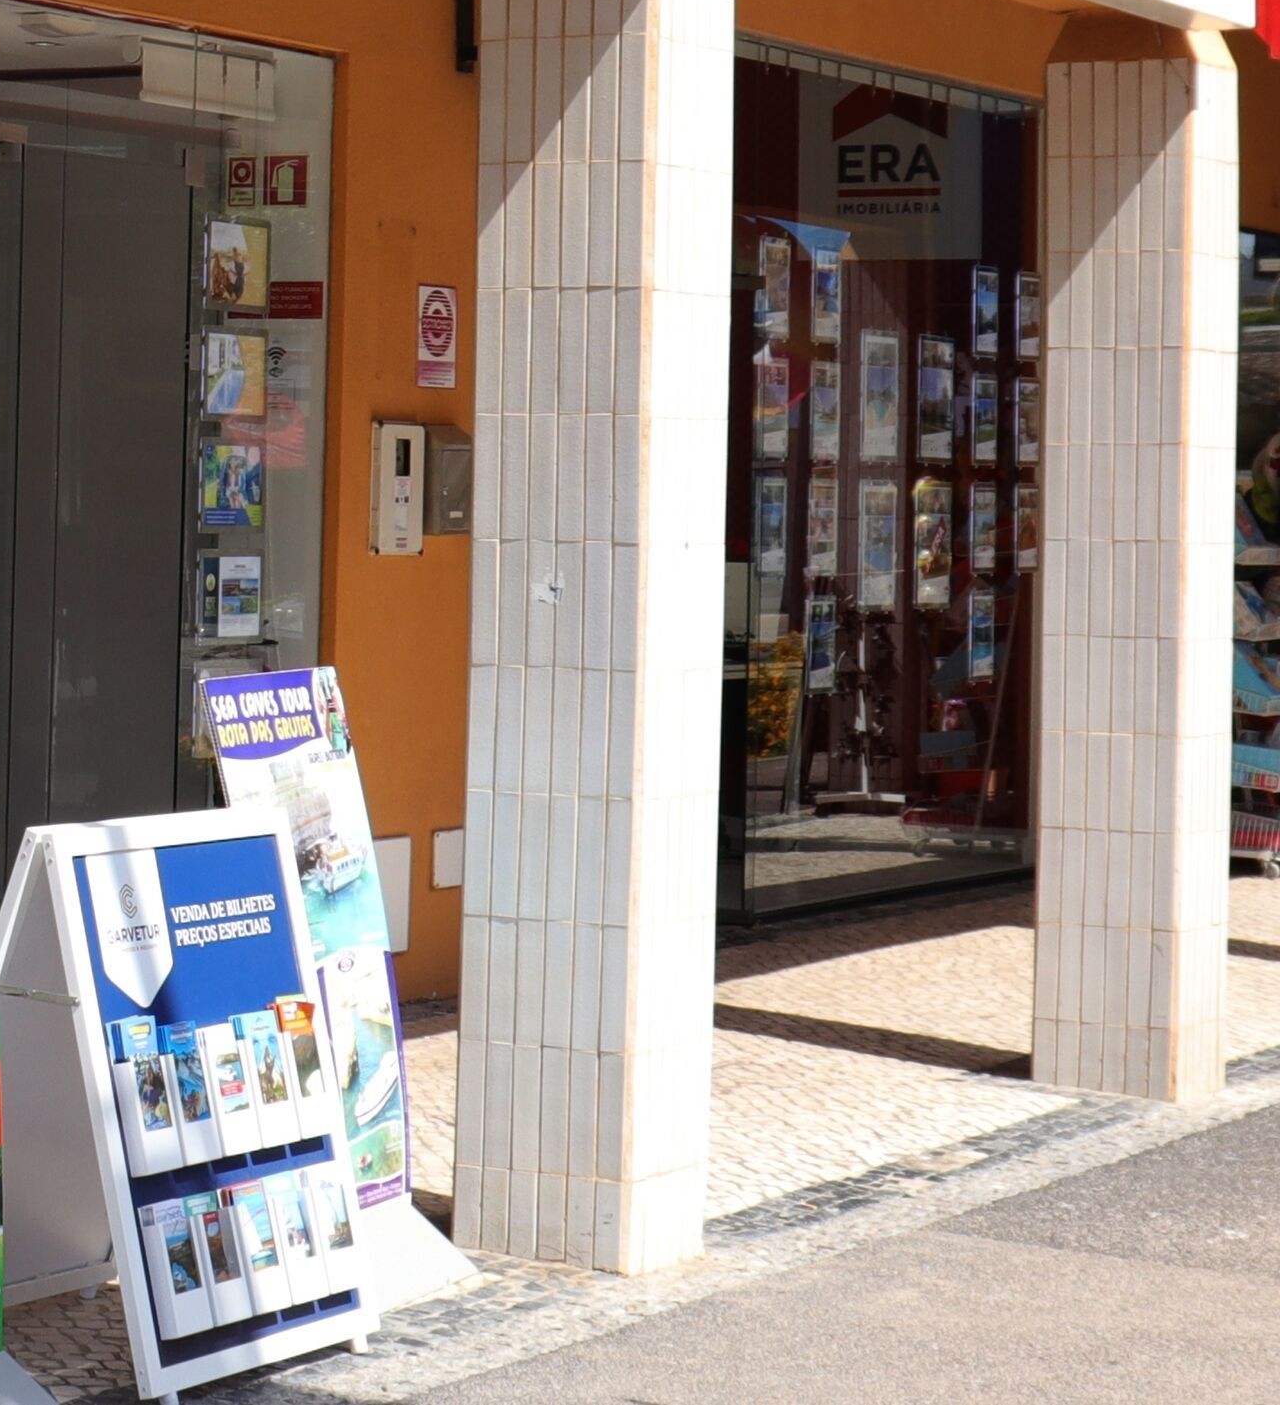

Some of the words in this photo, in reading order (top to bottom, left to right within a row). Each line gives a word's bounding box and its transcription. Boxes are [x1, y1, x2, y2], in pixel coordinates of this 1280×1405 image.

[838, 143, 941, 183] ERA
[837, 201, 942, 215] IMOBILIÁRIA
[211, 695, 238, 723] SEA
[240, 689, 279, 718] CAVES
[279, 686, 312, 713] TOUR
[217, 722, 249, 748] ROTA
[250, 719, 274, 743] DAS
[275, 714, 315, 740] GRUTAS
[170, 905, 210, 923] VENDA
[210, 903, 226, 918] DE
[226, 894, 276, 914] BILHETES
[106, 924, 160, 944] GARVETUR
[175, 926, 218, 948] PREÇOS
[218, 917, 271, 939] ESPECIAIS
